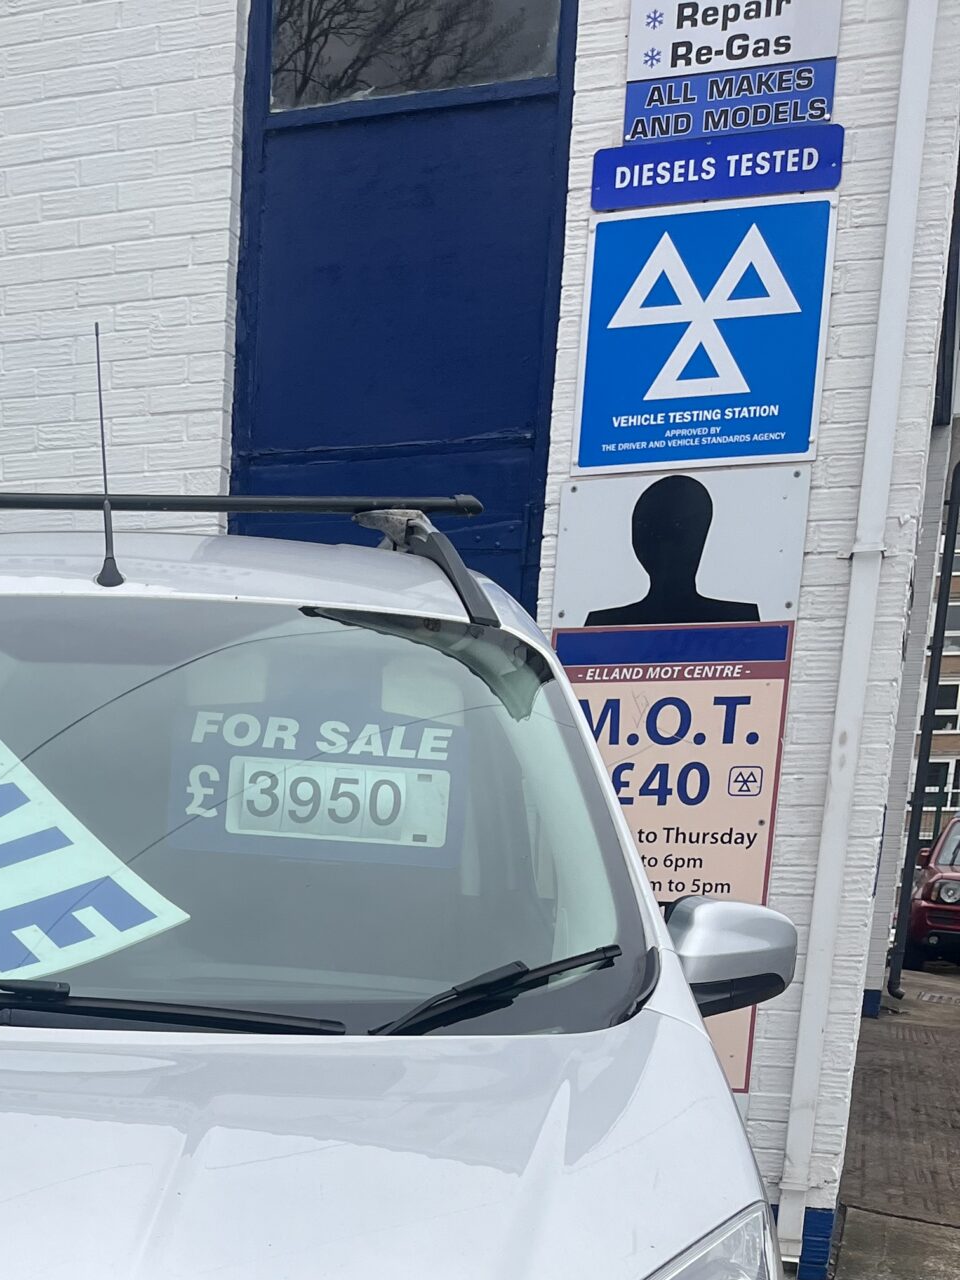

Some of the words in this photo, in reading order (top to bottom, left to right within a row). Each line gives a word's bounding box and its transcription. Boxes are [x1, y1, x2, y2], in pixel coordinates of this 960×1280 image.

[676, 0, 791, 31] Repair
[670, 33, 792, 68] Re-Gas
[645, 82, 697, 108] ALL
[707, 67, 814, 101] MAKES
[630, 114, 692, 140] AND
[702, 98, 827, 132] MODELS
[615, 157, 716, 189] DIESELS
[727, 148, 819, 177] TESTED
[612, 412, 665, 428] VEHICLE
[668, 408, 721, 424] TESTING
[724, 404, 779, 420] STATION
[664, 427, 708, 438] APPROVED
[710, 426, 722, 435] BY
[601, 444, 617, 452] THE
[618, 442, 647, 451] DRIVER
[648, 440, 666, 449] AND
[667, 438, 700, 447] VEHICLE
[701, 434, 751, 445] STANDARDS
[752, 432, 786, 442] AGENCY
[586, 667, 642, 681] ELLAND
[645, 666, 681, 680] MOT
[683, 664, 743, 679] CENTRE
[190, 711, 300, 751] FOR
[315, 720, 453, 761] SALE
[578, 695, 760, 746] M.O.T.
[185, 764, 220, 818] £
[246, 770, 402, 826] 3950
[612, 761, 710, 806] £40
[637, 828, 658, 844] to
[662, 827, 758, 849] Thursday
[640, 854, 658, 868] to
[663, 854, 703, 872] 6pm
[668, 880, 685, 892] to
[690, 879, 731, 895] 5pm
